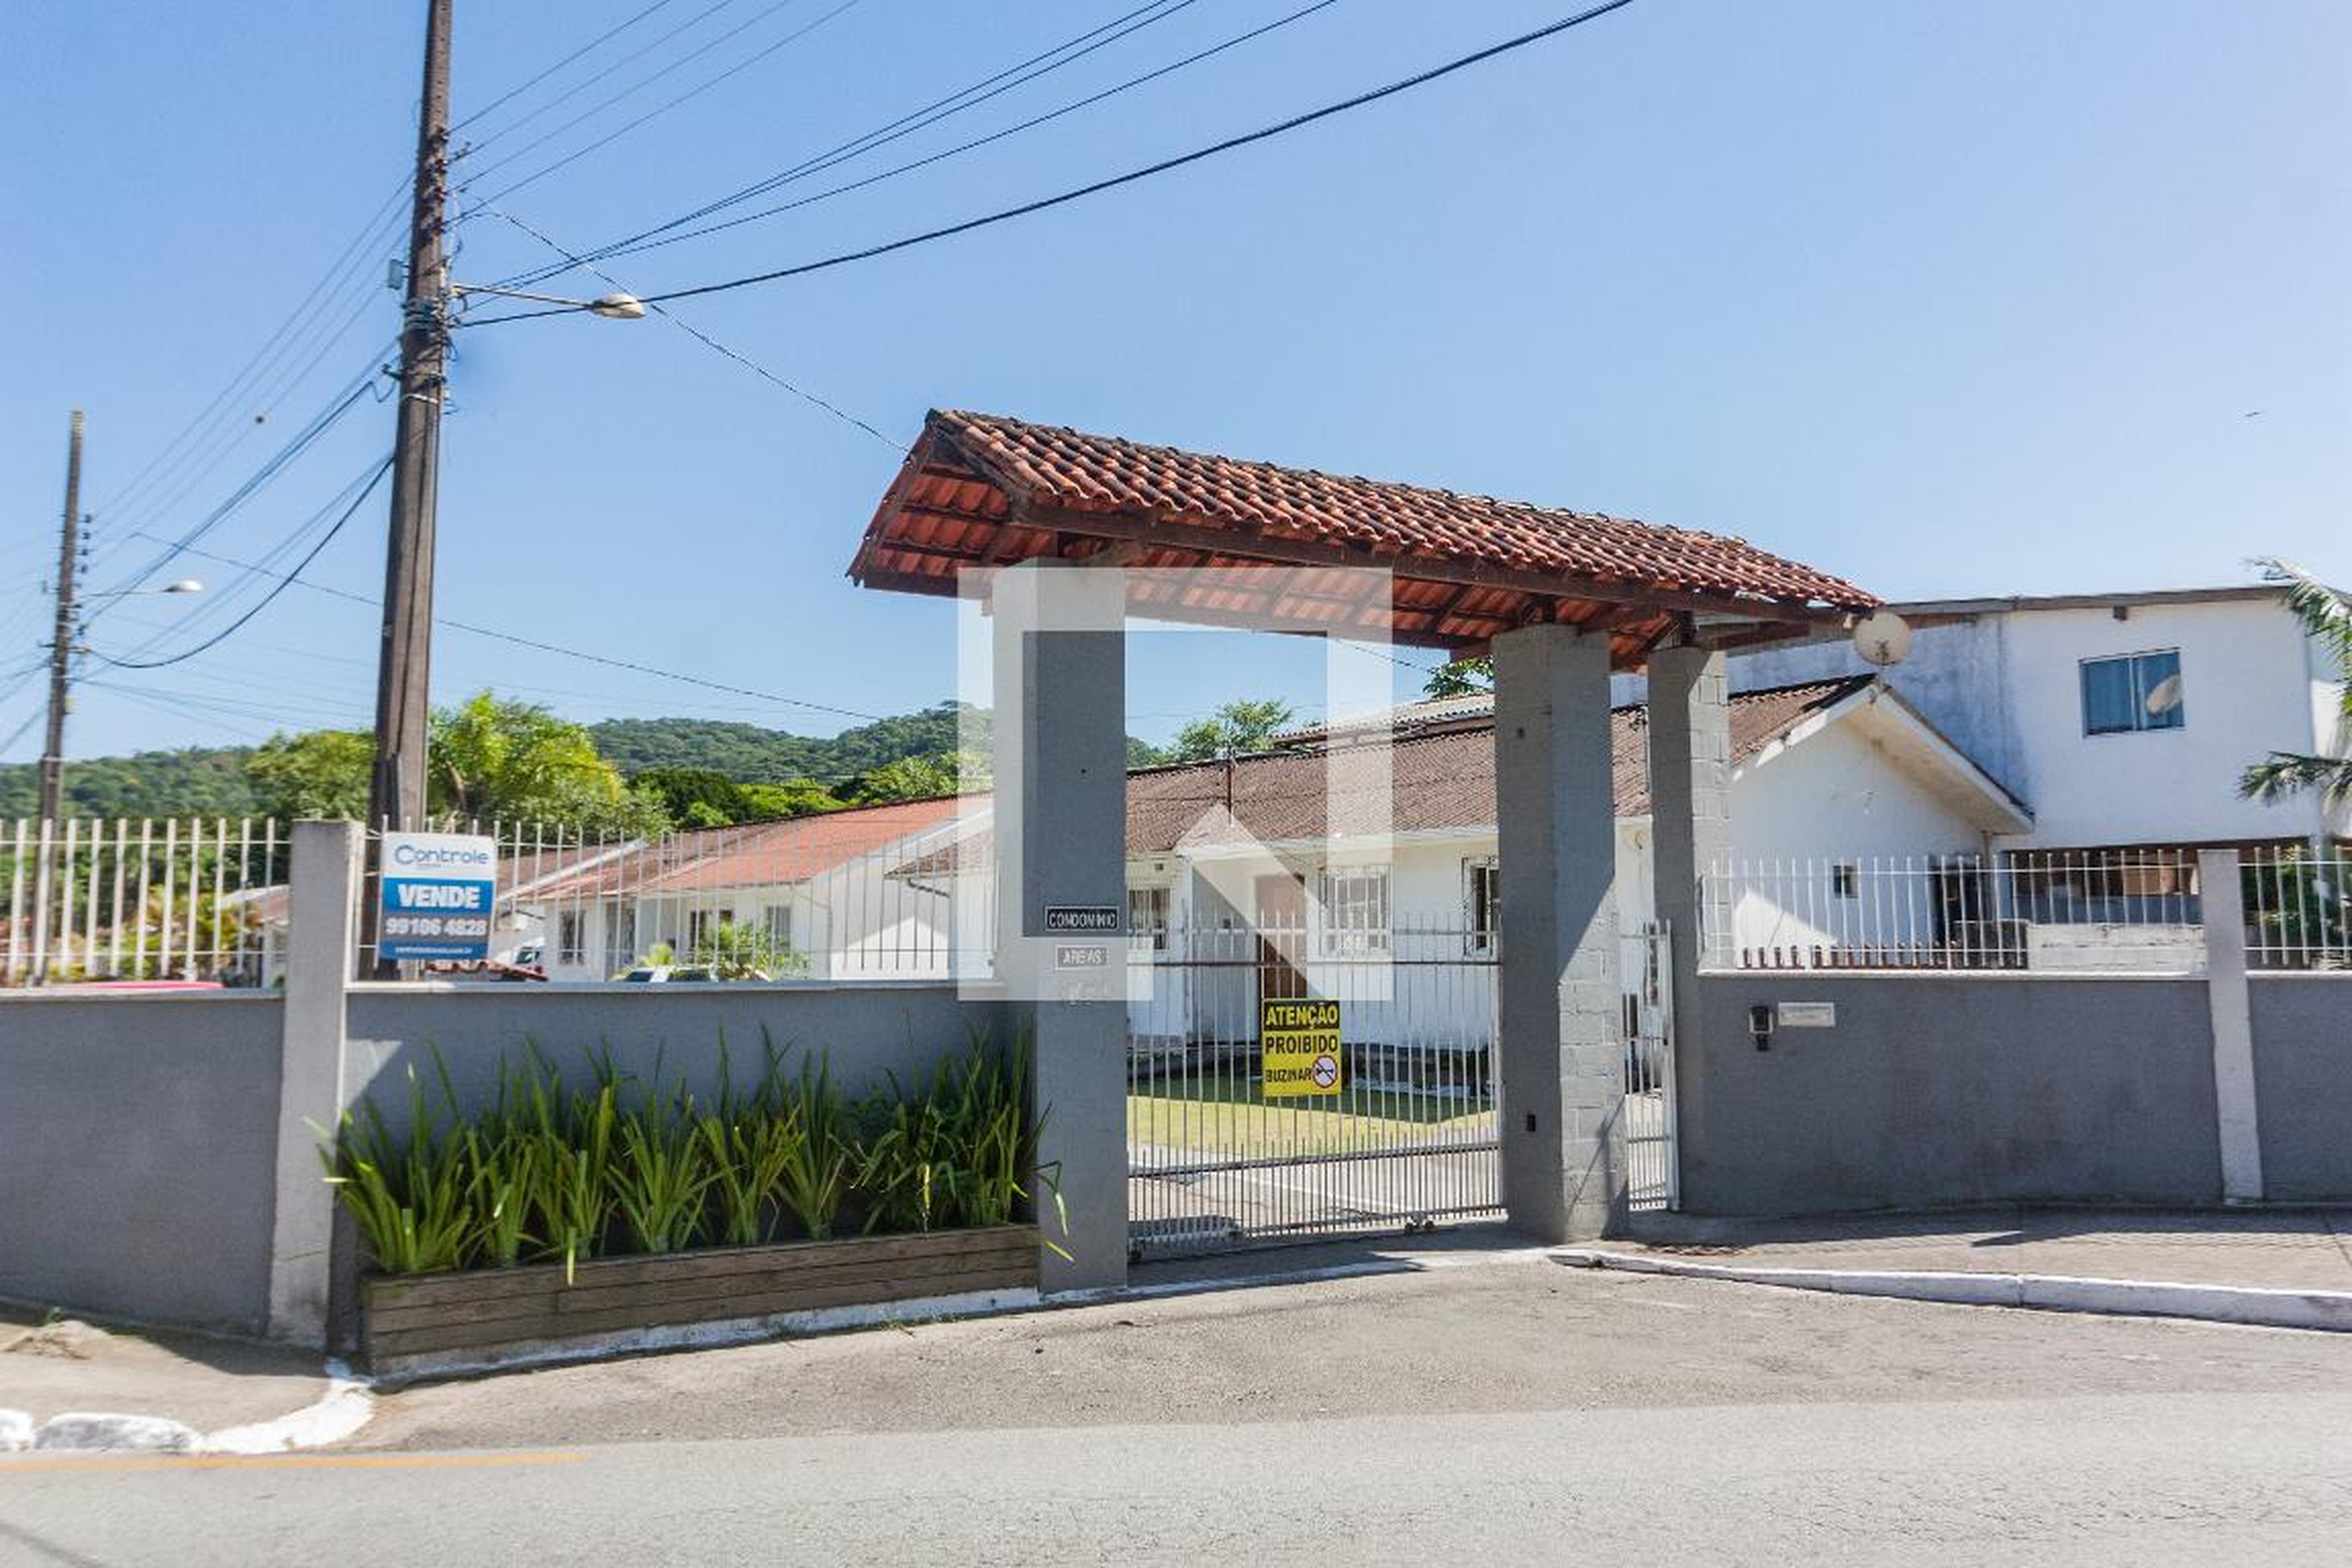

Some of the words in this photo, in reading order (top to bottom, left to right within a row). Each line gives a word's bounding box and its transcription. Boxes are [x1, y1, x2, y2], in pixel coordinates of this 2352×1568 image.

[395, 845, 489, 865] Controle
[398, 884, 481, 908] VENDE
[1265, 1002, 1338, 1030] ATENÇÃO
[1265, 1035, 1338, 1054] PROIBIDO
[1265, 1068, 1312, 1083] BUZINAR
